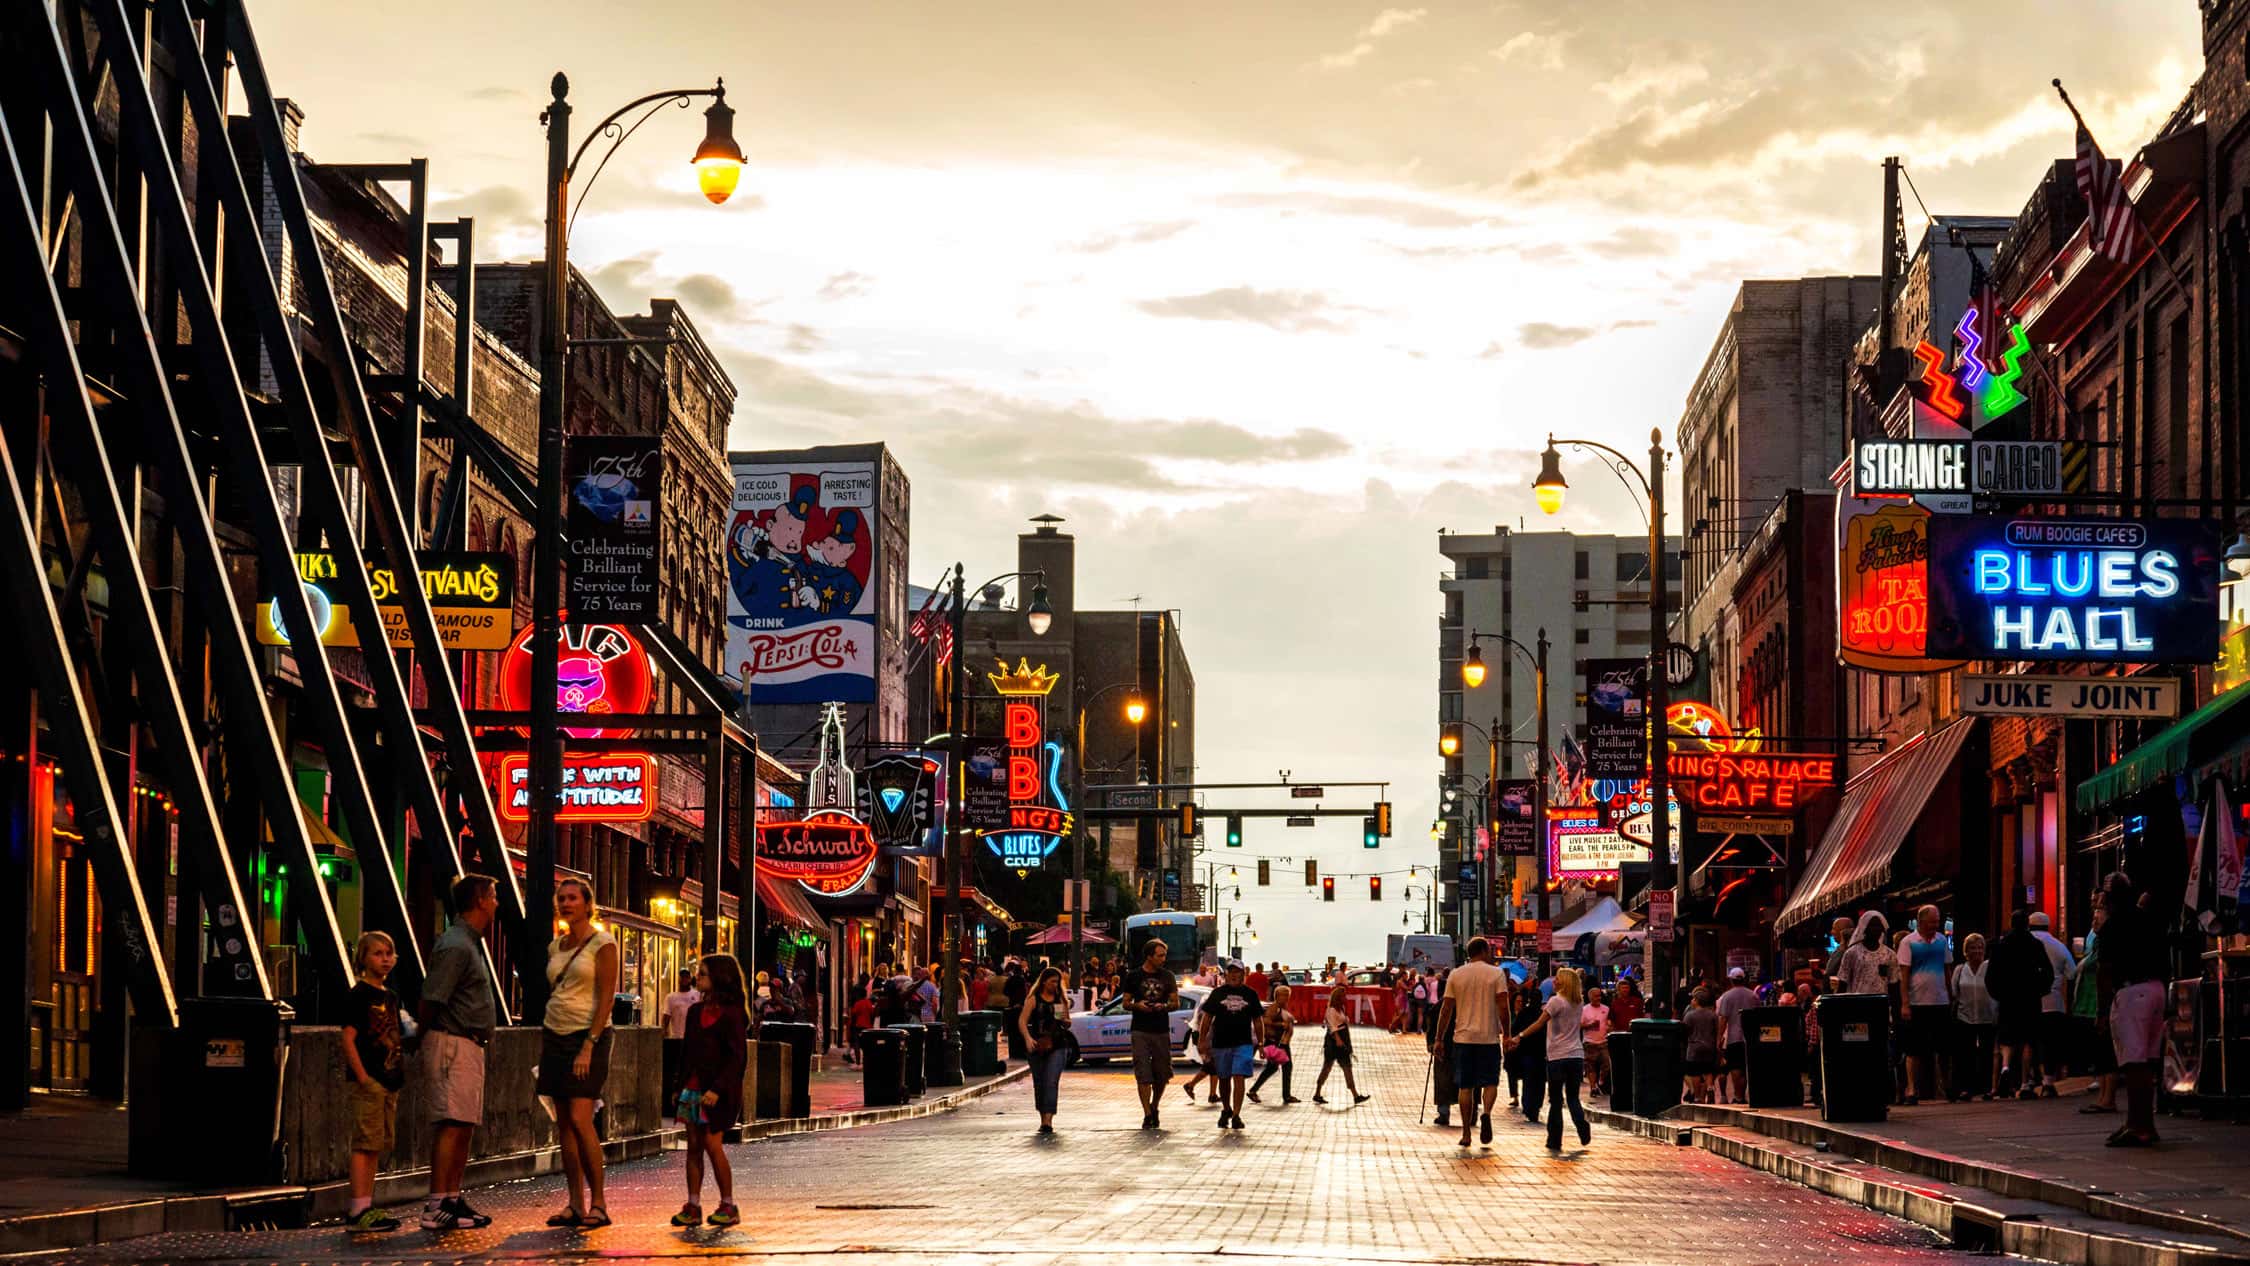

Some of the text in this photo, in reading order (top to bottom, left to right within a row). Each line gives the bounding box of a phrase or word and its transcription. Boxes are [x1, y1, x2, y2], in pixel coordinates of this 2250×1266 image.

[593, 450, 658, 488] 75th
[1861, 443, 2058, 491] STRANGE CARGO
[742, 480, 778, 491] ICE COLD
[824, 479, 871, 490] ARRESTING
[738, 491, 781, 501] DELICIOUS
[833, 491, 857, 501] TASTE
[1940, 501, 1969, 510] GREAT
[2016, 526, 2042, 540] RUM
[2046, 527, 2092, 541] BOOGIE
[571, 538, 654, 559] Celebrating
[582, 557, 643, 573] Brilliant
[1974, 550, 2180, 598] BLUES
[573, 576, 652, 592] Service for
[581, 596, 642, 611] 75 Years
[745, 618, 785, 629] DRINK
[1994, 606, 2154, 651] HALL
[1666, 647, 1695, 684] LUB
[1603, 666, 1645, 688] 75th
[1976, 684, 2161, 711] JUKE JOINT
[1590, 724, 1644, 737] Celebrating
[1598, 736, 1636, 748] Brilliant
[1591, 748, 1643, 760] Service for
[1596, 761, 1637, 771] 75 Years
[584, 767, 640, 782] WITH
[1700, 783, 1794, 806] CAFE
[777, 828, 865, 855] Schwab
[1004, 836, 1040, 855] BLUES
[1569, 844, 1584, 852] EARL
[1588, 843, 1599, 852] THE
[1584, 836, 1602, 844] MUSIC
[1004, 856, 1041, 867] CLUB
[1654, 892, 1670, 902] NO
